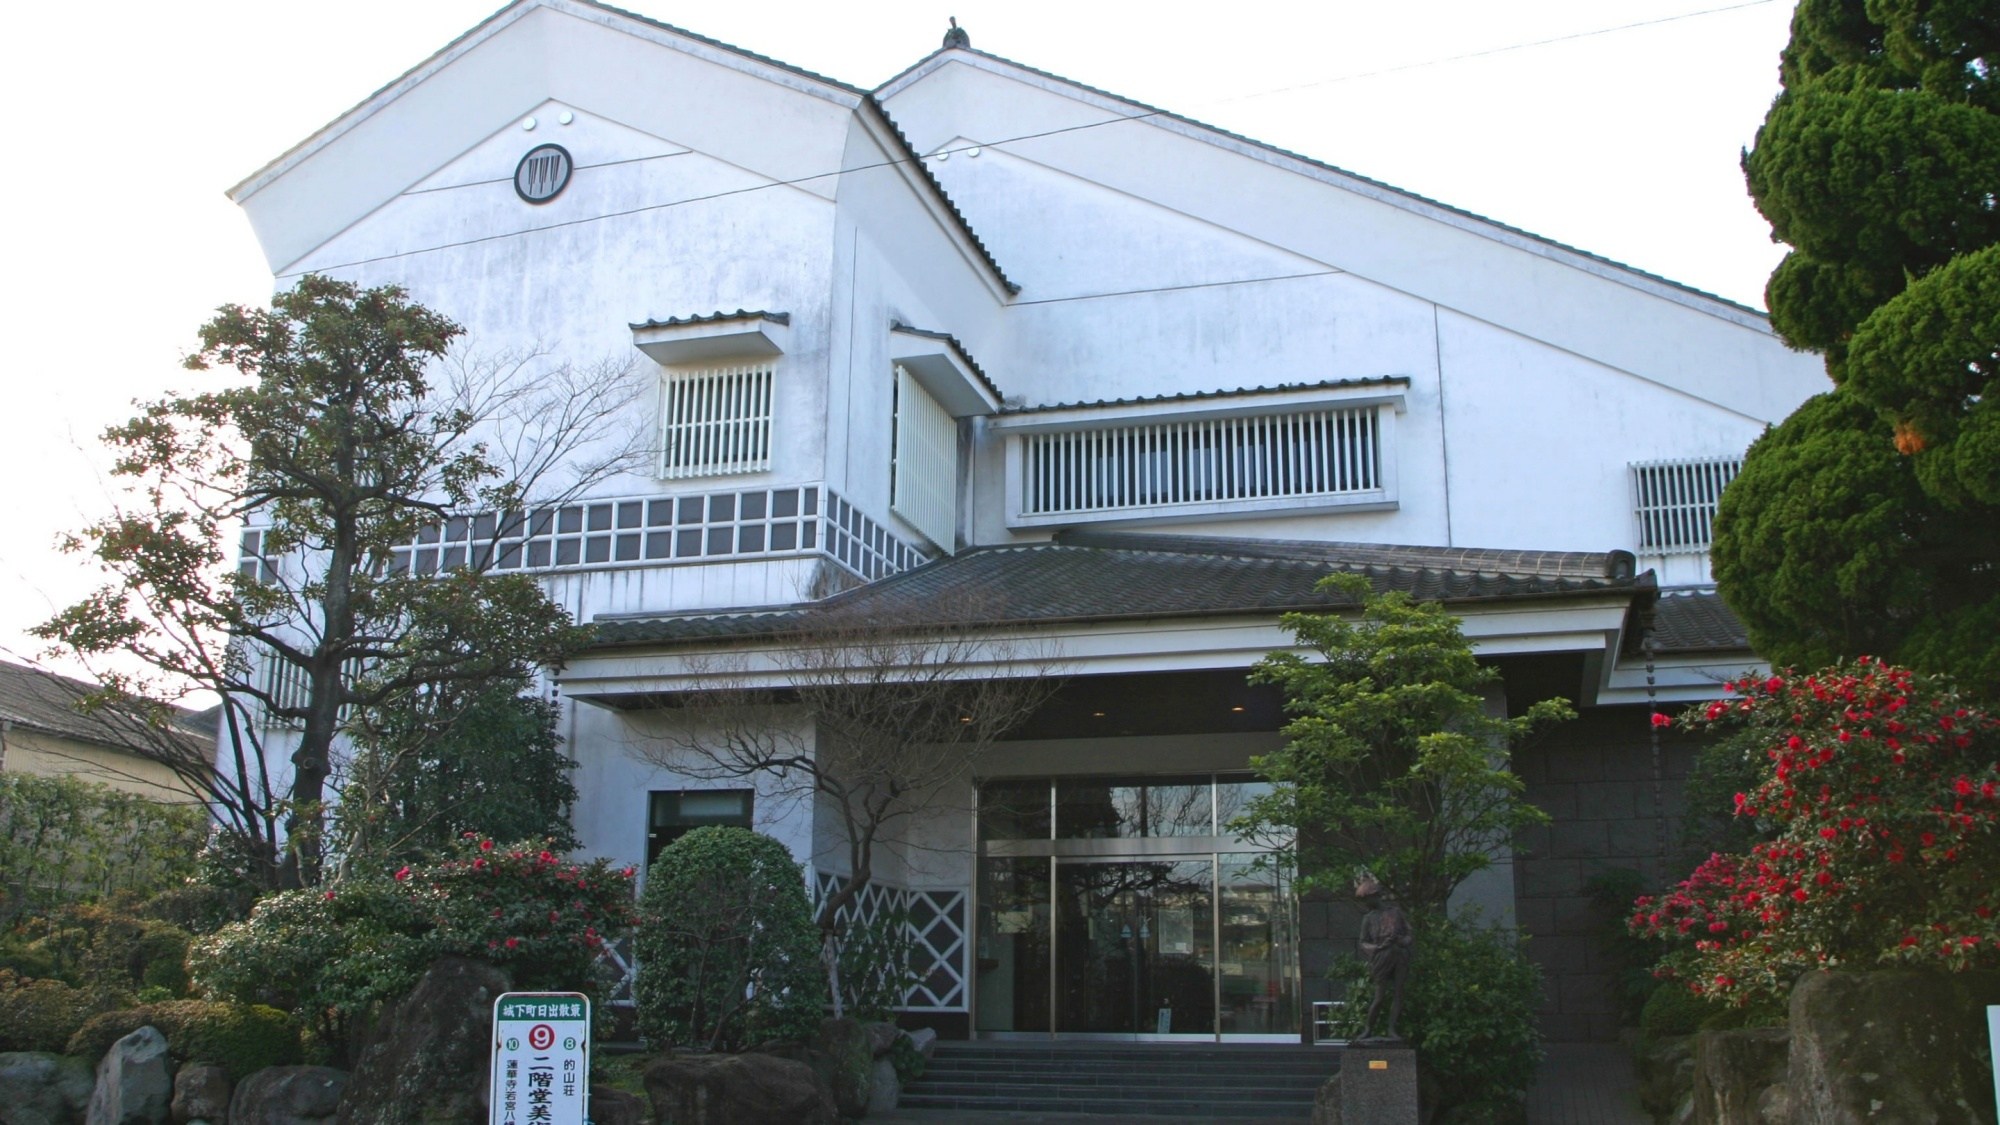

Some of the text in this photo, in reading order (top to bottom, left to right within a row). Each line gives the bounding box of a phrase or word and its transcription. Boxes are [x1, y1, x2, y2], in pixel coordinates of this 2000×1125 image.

[533, 1026, 550, 1048] 9
[563, 1059, 575, 1097] 的山荘
